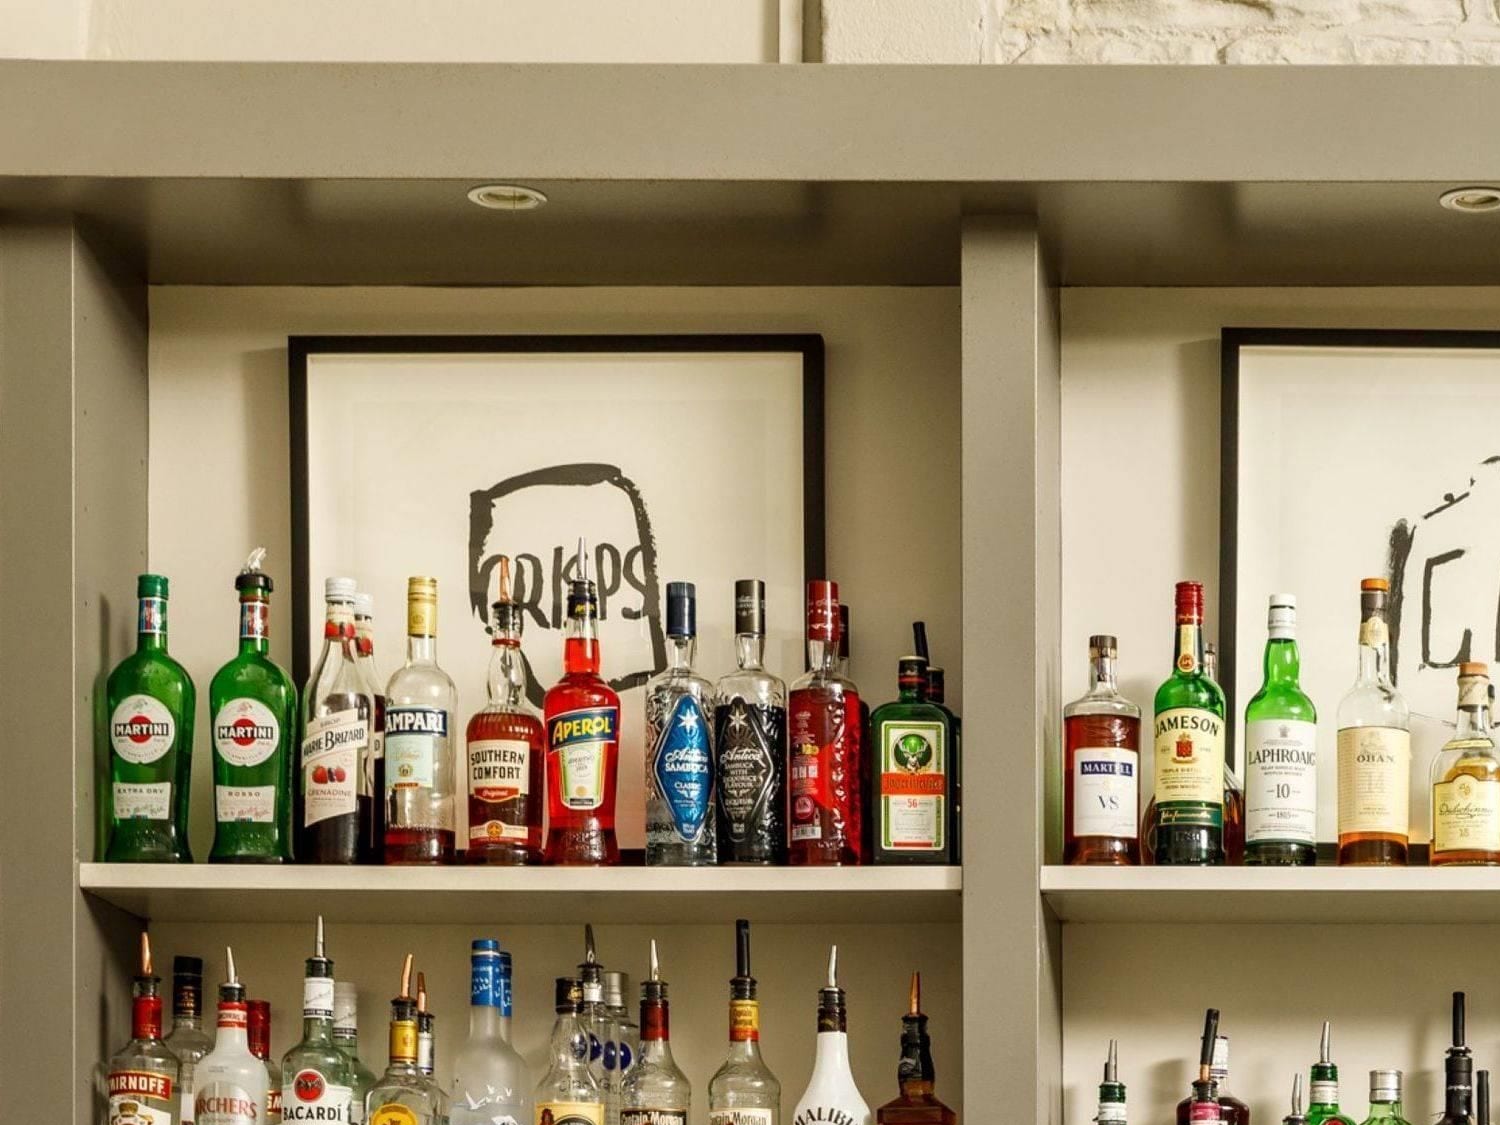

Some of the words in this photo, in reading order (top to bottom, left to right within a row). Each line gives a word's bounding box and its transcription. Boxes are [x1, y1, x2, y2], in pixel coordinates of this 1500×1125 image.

[385, 711, 445, 732] AMPARI
[1155, 716, 1219, 738] JAMESON
[116, 724, 168, 736] MARTINI
[219, 727, 273, 739] MARTINI
[553, 717, 612, 743] APEROL
[325, 728, 365, 751] BRIZARD
[471, 749, 525, 765] SOUTHERN
[1249, 749, 1316, 766] LAPHROAIG
[1357, 755, 1395, 764] OBAN
[473, 765, 521, 780] COMFORT
[1082, 761, 1132, 776] MARTLL
[1276, 783, 1291, 799] 10
[1098, 794, 1119, 810] VS
[109, 1075, 166, 1096] MIRNOFF
